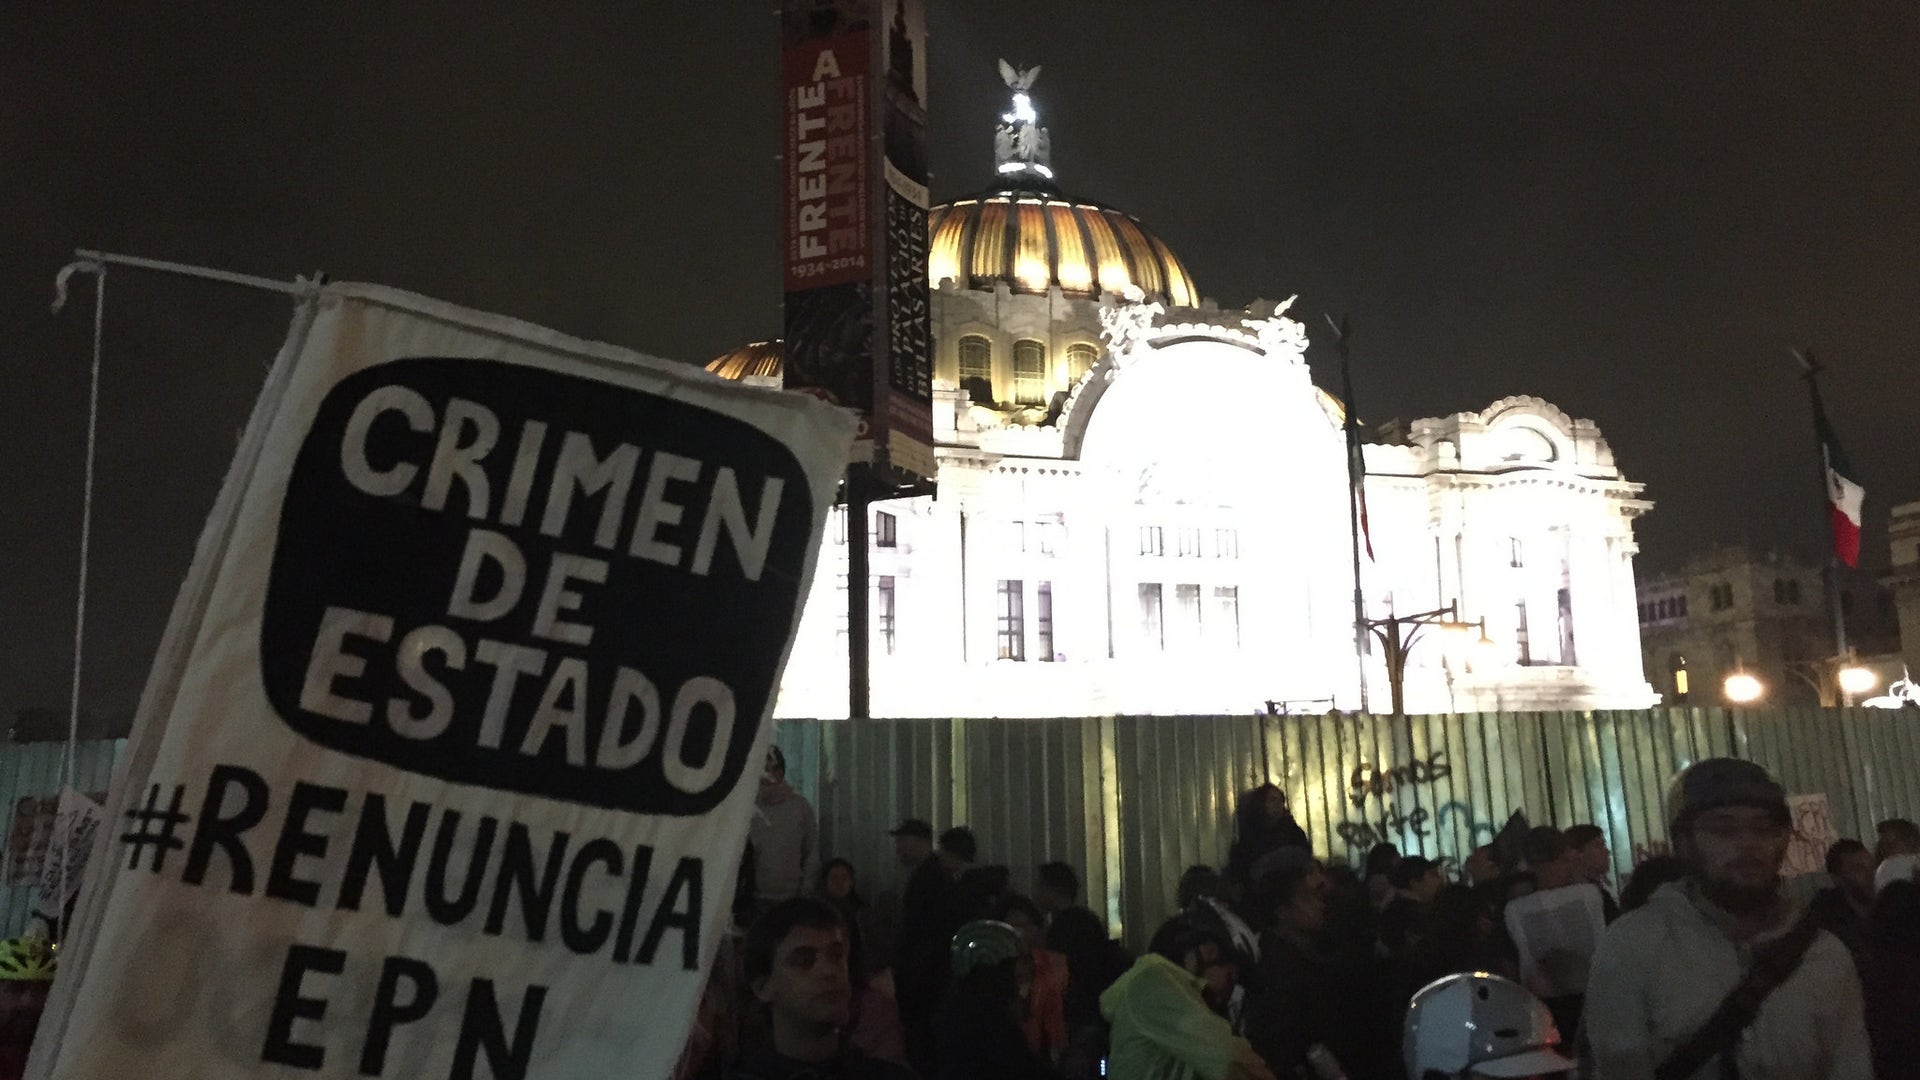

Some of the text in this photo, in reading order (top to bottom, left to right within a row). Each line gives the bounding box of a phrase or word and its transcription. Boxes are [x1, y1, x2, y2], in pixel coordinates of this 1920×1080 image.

[798, 49, 841, 259] FRENTE A
[792, 255, 865, 278] 1934-2014
[898, 228, 914, 353] PALACIO
[910, 208, 928, 397] BELLAS ARTES
[340, 384, 784, 582] CRIMEN
[447, 528, 609, 646] DE
[299, 605, 737, 796] ESTADO
[120, 764, 704, 971] #RENUNCIA
[261, 944, 548, 1080] EPN
